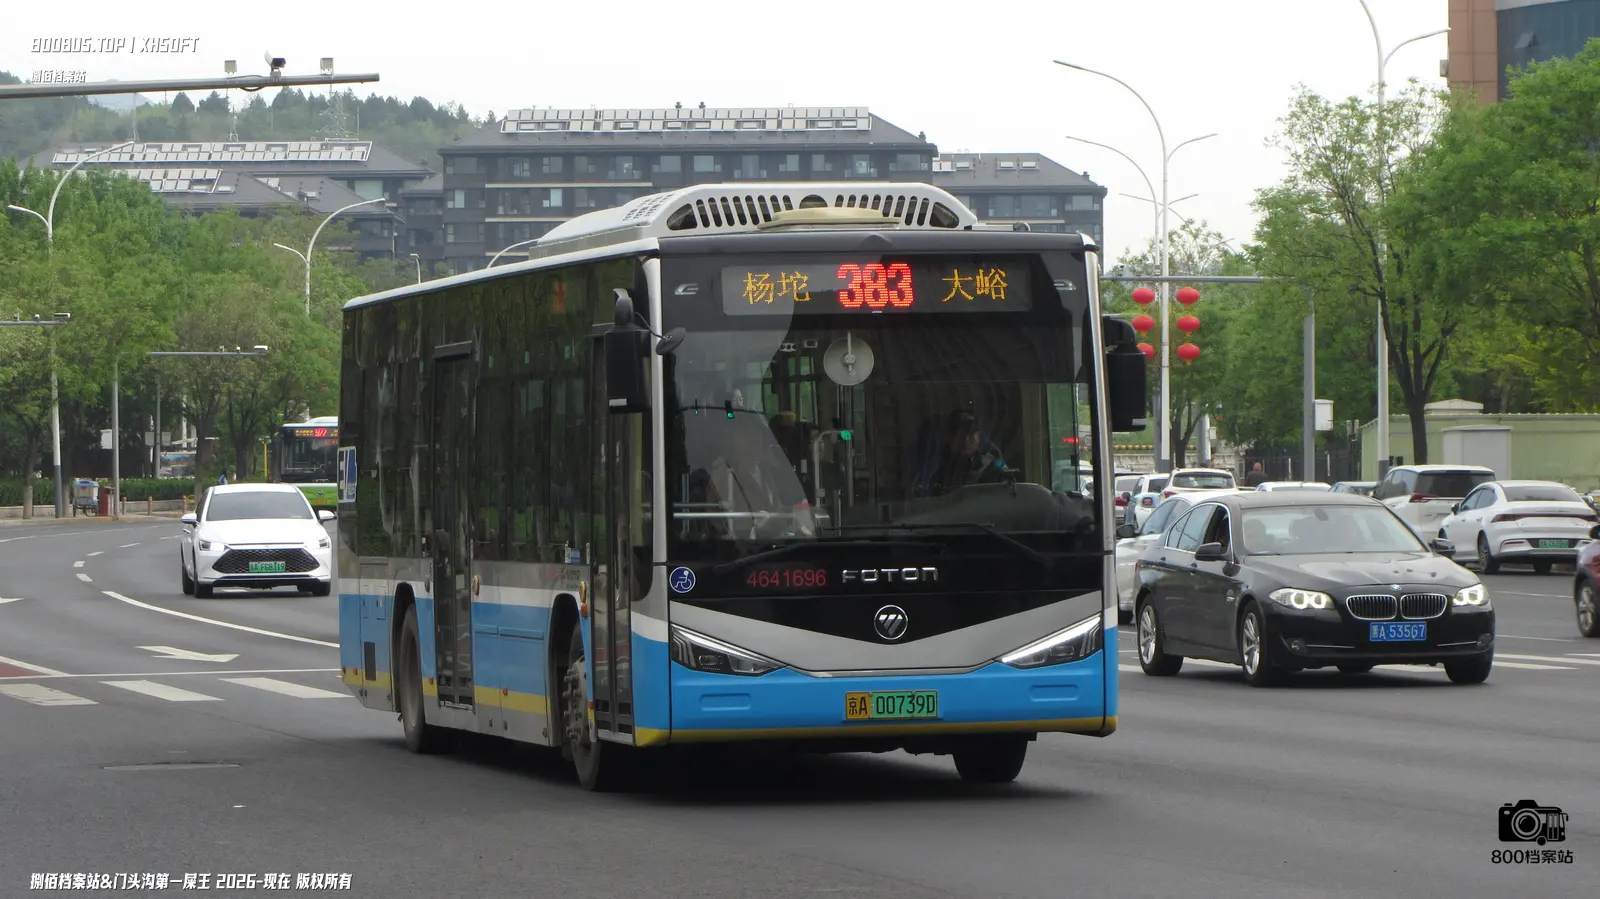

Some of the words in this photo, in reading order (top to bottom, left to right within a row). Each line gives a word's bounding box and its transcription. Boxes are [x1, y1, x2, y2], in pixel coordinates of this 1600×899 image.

[743, 270, 811, 305] 杨坨
[837, 262, 914, 308] 383
[941, 267, 1009, 302] 大峪
[747, 569, 827, 588] 4641696
[842, 567, 939, 584] FOTON
[876, 694, 935, 715] 00739D
